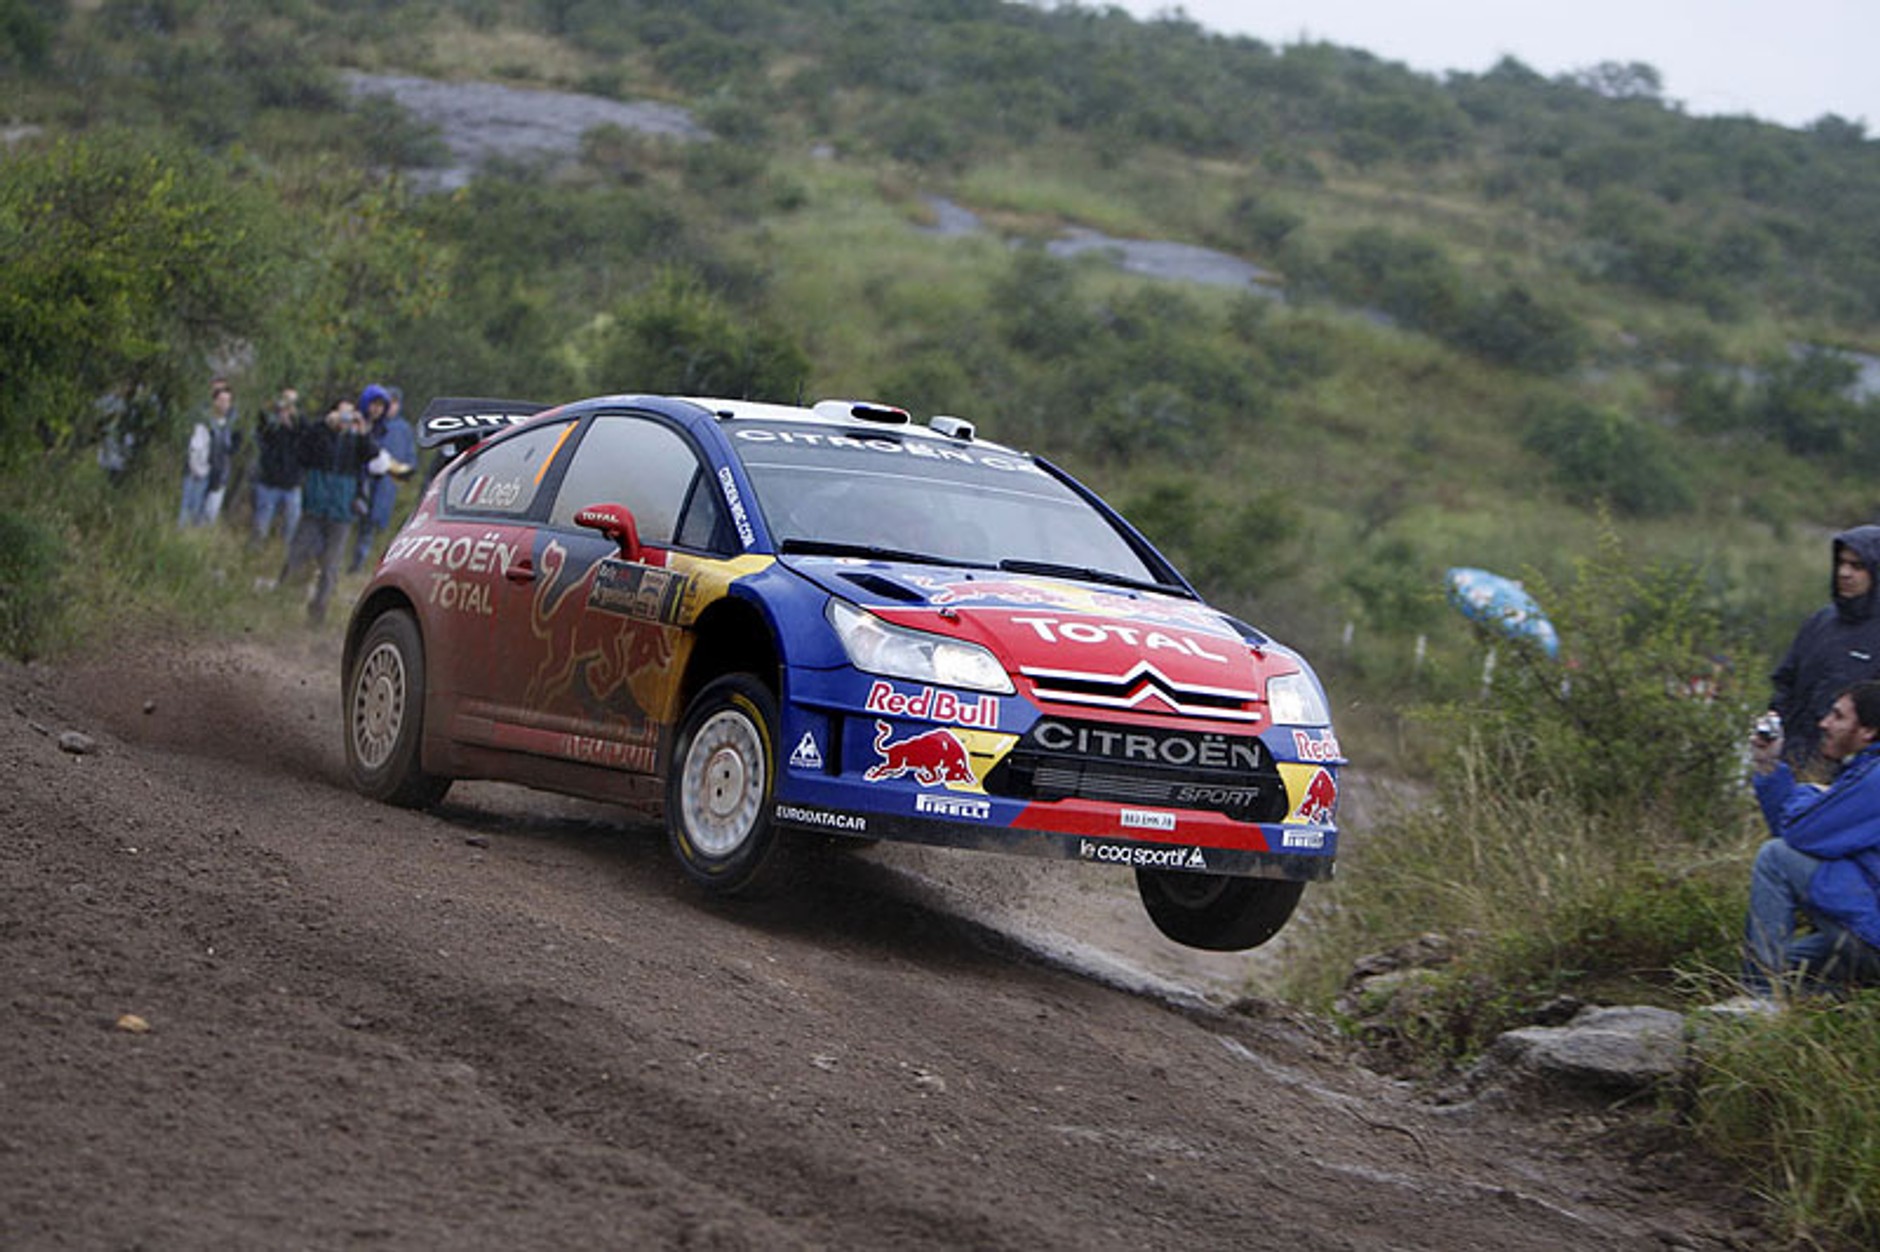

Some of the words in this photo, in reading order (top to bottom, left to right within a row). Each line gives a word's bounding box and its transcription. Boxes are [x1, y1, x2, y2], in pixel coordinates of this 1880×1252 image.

[480, 477, 520, 506] Loeb
[583, 512, 619, 523] TOTAL
[383, 532, 518, 576] CITROËN
[429, 573, 493, 614] TOTAL
[1012, 616, 1229, 663] TOTAL
[865, 680, 933, 718] Red
[931, 691, 999, 729] Bull
[1033, 721, 1260, 768] CITROËN
[915, 793, 991, 819] PIRELLI
[1176, 785, 1259, 807] SPORT
[776, 805, 867, 831] EURODATACAR
[1080, 838, 1096, 858] le
[1097, 844, 1133, 865] coq
[1132, 847, 1189, 866] sportif
